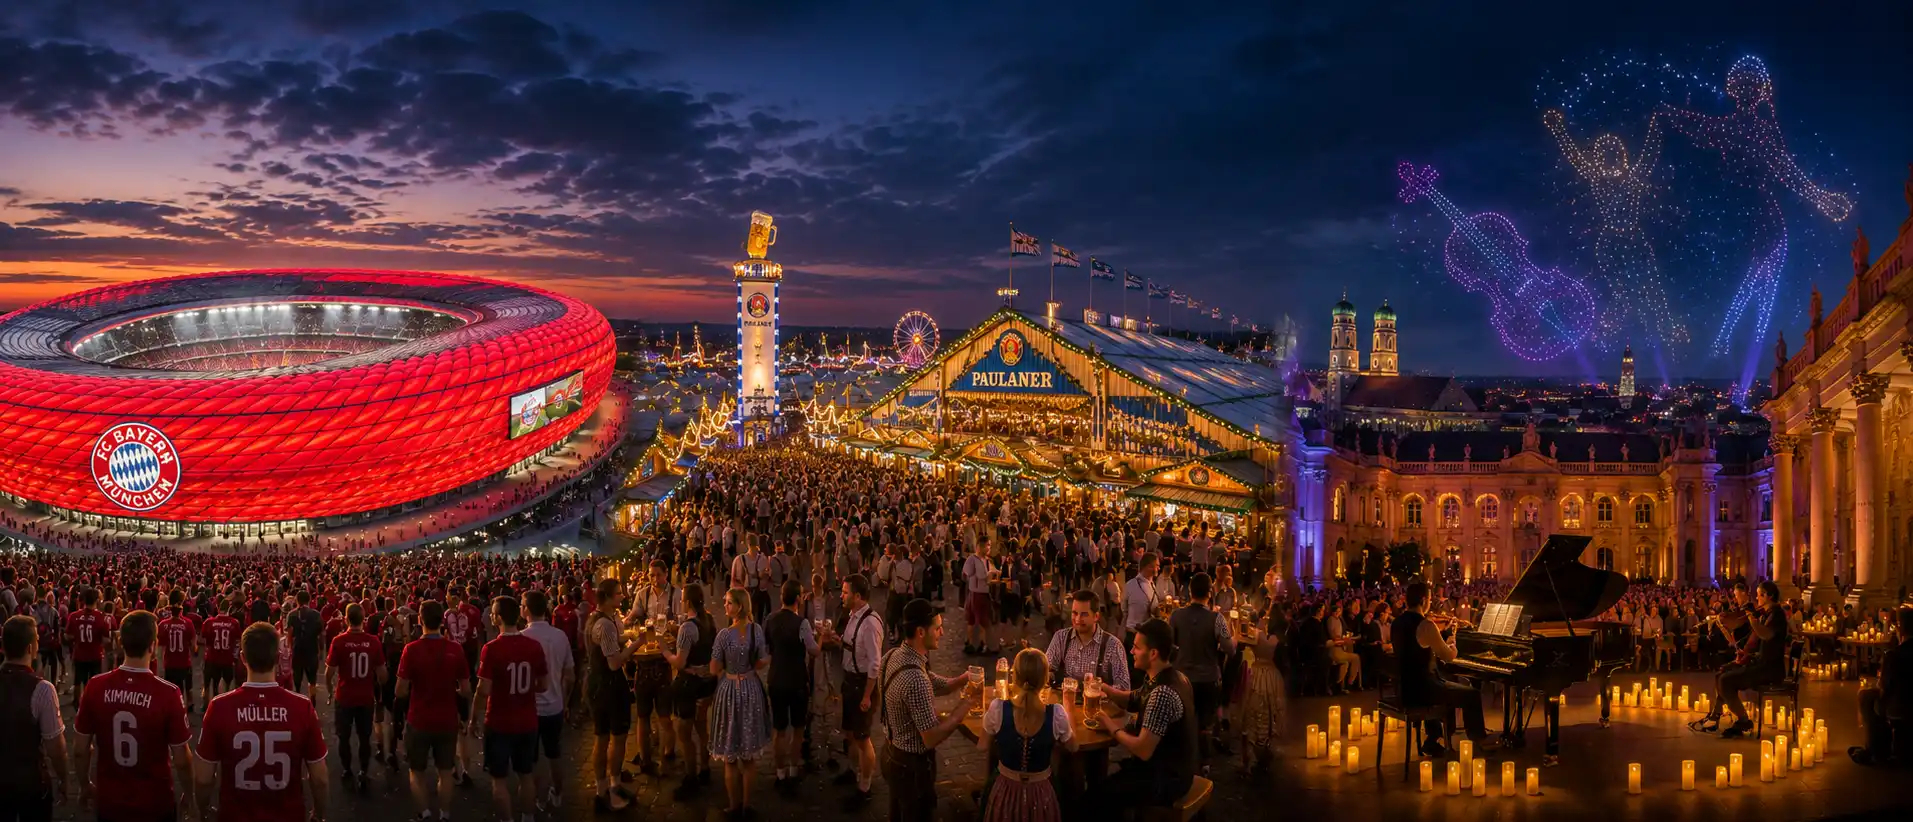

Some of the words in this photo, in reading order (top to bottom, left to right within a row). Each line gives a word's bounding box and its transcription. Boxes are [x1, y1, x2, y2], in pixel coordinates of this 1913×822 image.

[972, 371, 1053, 388] PAULANER
[96, 440, 112, 461] FC
[113, 427, 174, 465] BAYERN
[349, 652, 369, 678] 10
[507, 661, 531, 695] 10
[103, 689, 152, 709] KIMMICH
[237, 704, 288, 722] MÜLLER
[112, 710, 138, 768] 6
[233, 731, 292, 790] 25
